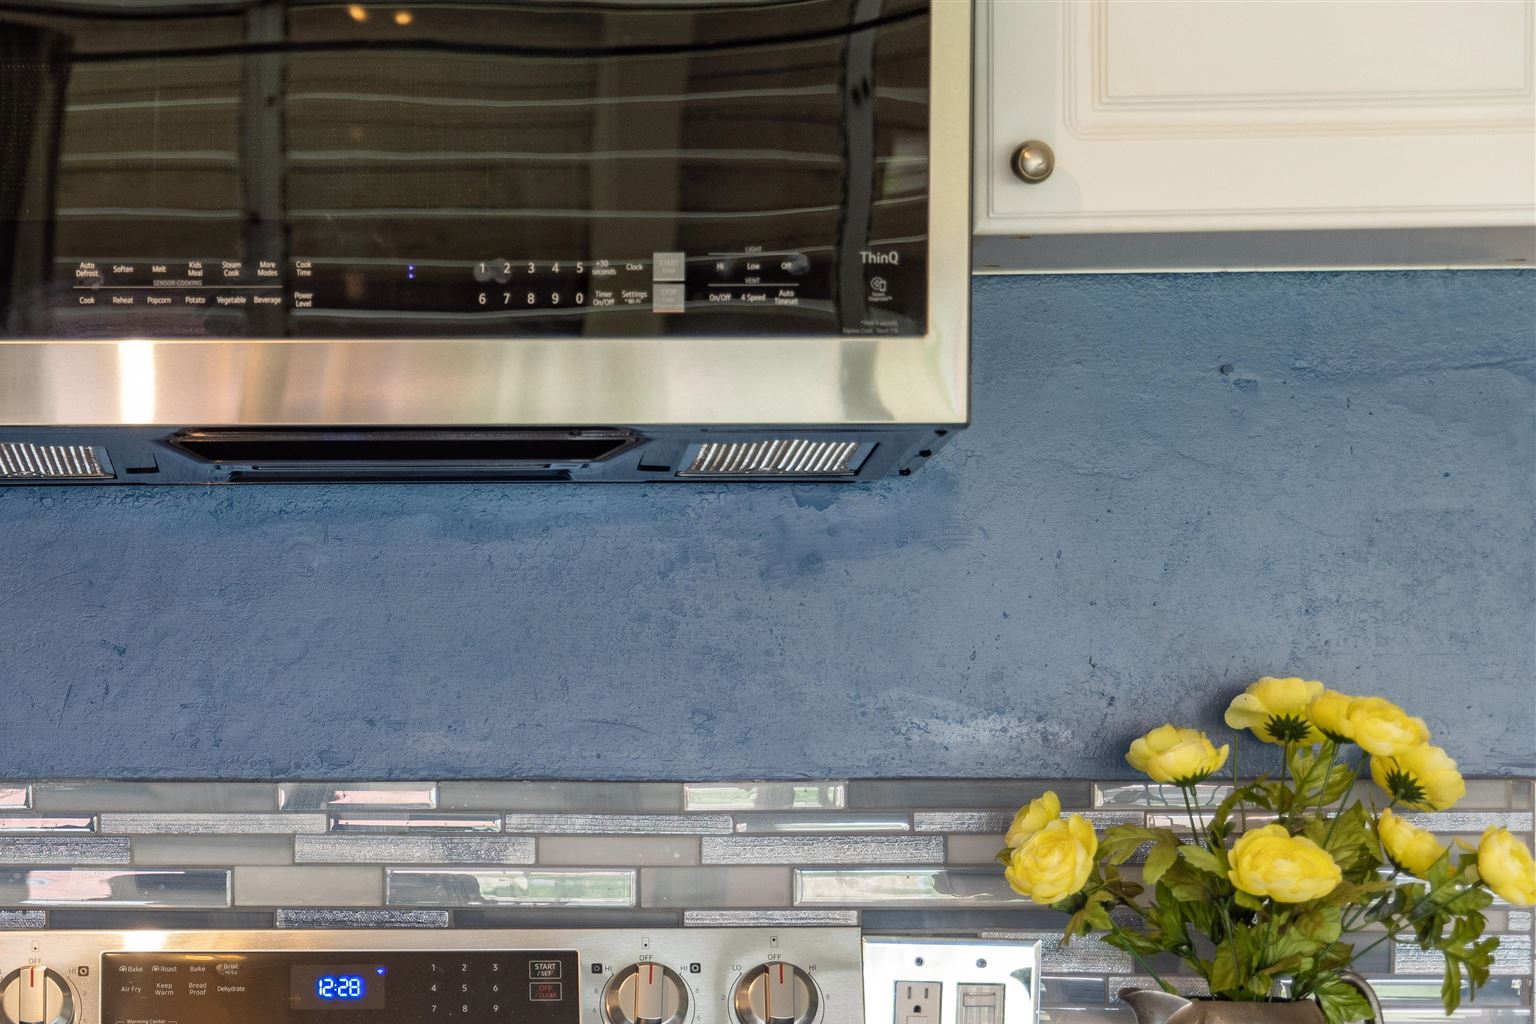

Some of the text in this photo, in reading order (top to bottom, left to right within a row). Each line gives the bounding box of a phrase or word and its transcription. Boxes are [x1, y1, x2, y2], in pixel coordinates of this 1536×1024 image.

[859, 250, 899, 266] ThinQ
[113, 265, 134, 273] Soften
[152, 265, 166, 273] Melt
[188, 261, 202, 269] Kids
[222, 261, 242, 269] Steam
[260, 261, 276, 269] More
[296, 261, 312, 269] Cook
[503, 263, 511, 273] 2
[527, 263, 535, 273] 3
[551, 263, 560, 273] 4
[576, 263, 583, 273] 5
[626, 263, 643, 271] Clock
[717, 262, 724, 270] Hi
[781, 262, 792, 270] Off
[188, 269, 203, 277] Meal
[224, 269, 240, 277] Cook
[257, 269, 278, 277] Modes
[592, 268, 616, 276] seconds
[595, 290, 612, 298] Timer
[622, 290, 647, 300] Settings
[778, 289, 794, 298] Auto
[79, 296, 95, 304] Cook
[112, 296, 134, 304] Reheat
[147, 296, 172, 306] Popcorn
[185, 296, 206, 304] Potato
[216, 296, 246, 306] Vegetable
[253, 296, 282, 306] Beverage
[478, 293, 584, 304] 6 7 8 9 0
[593, 298, 615, 306] On/Off
[709, 294, 732, 302] On/Off
[747, 294, 766, 303] Speed
[774, 298, 798, 306] Timeset
[295, 300, 312, 308] Level
[127, 965, 143, 973] Bake
[160, 965, 177, 973] Roast
[189, 965, 206, 973] Bake
[534, 963, 556, 971] START
[318, 978, 360, 997] 12:28
